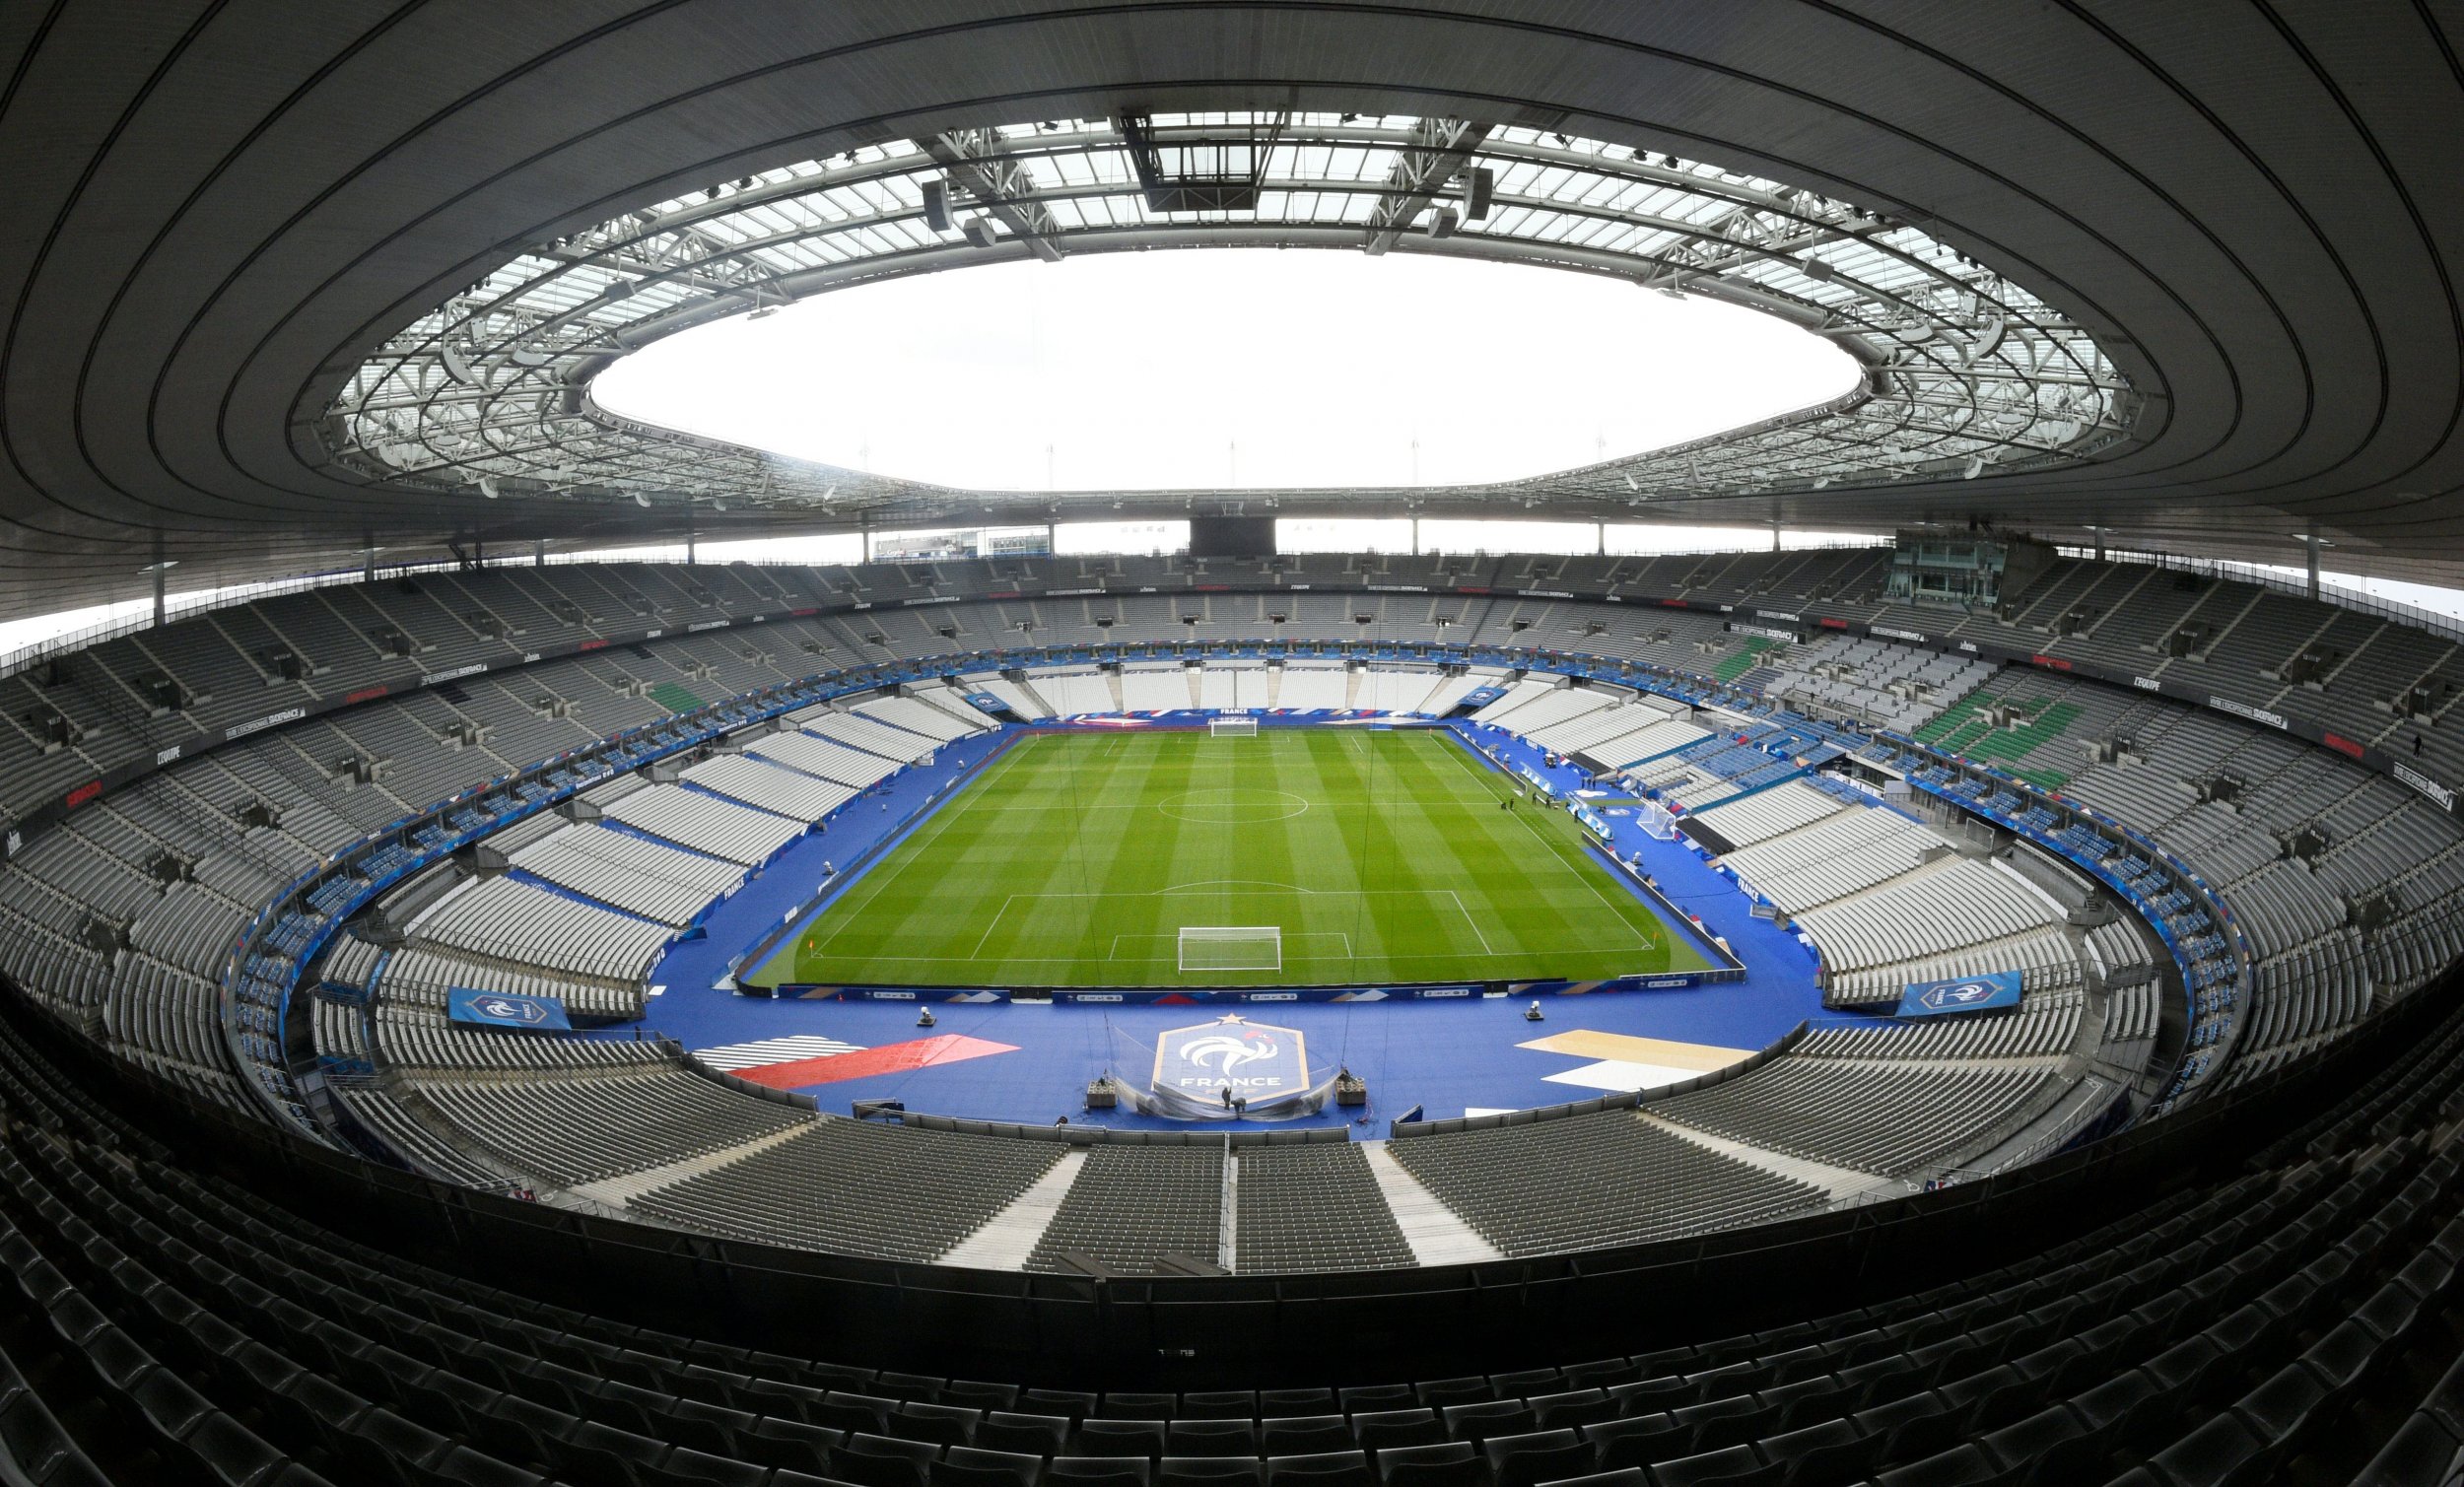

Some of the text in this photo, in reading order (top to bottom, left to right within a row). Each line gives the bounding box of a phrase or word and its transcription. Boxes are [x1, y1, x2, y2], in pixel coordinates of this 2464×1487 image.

[724, 876, 744, 901] FRANCE
[1737, 877, 1759, 903] FRANCE
[1180, 1076, 1282, 1087] FRANCE
